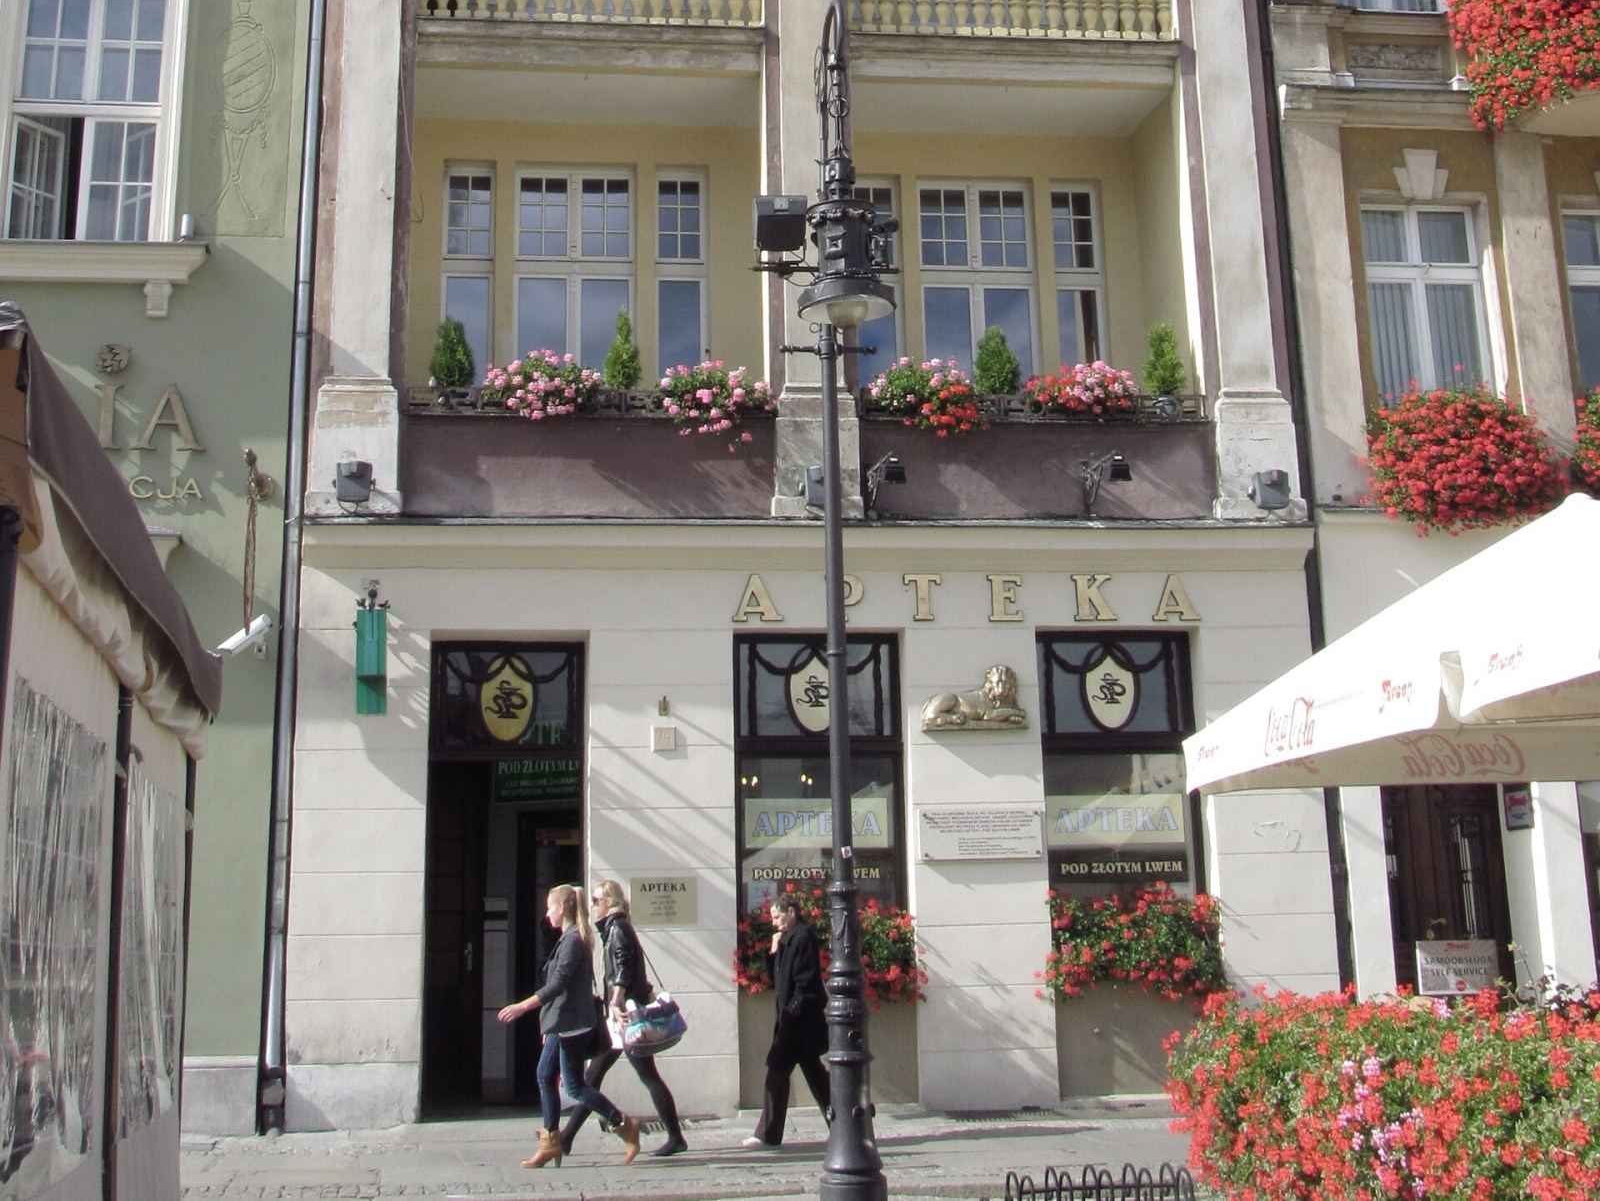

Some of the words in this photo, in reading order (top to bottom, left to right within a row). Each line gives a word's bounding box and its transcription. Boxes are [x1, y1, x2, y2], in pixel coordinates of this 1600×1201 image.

[128, 476, 202, 499] CJA
[731, 573, 1202, 622] APTEKA
[1056, 806, 1179, 833] APTEKA
[753, 868, 784, 880] POD
[786, 867, 832, 879] ZŁOTY
[1061, 863, 1088, 875] POD
[1092, 861, 1141, 874] ZŁOTYM
[1145, 861, 1183, 872] LWEM
[639, 882, 687, 893] APTEKA
[1452, 967, 1489, 976] SERVICE
